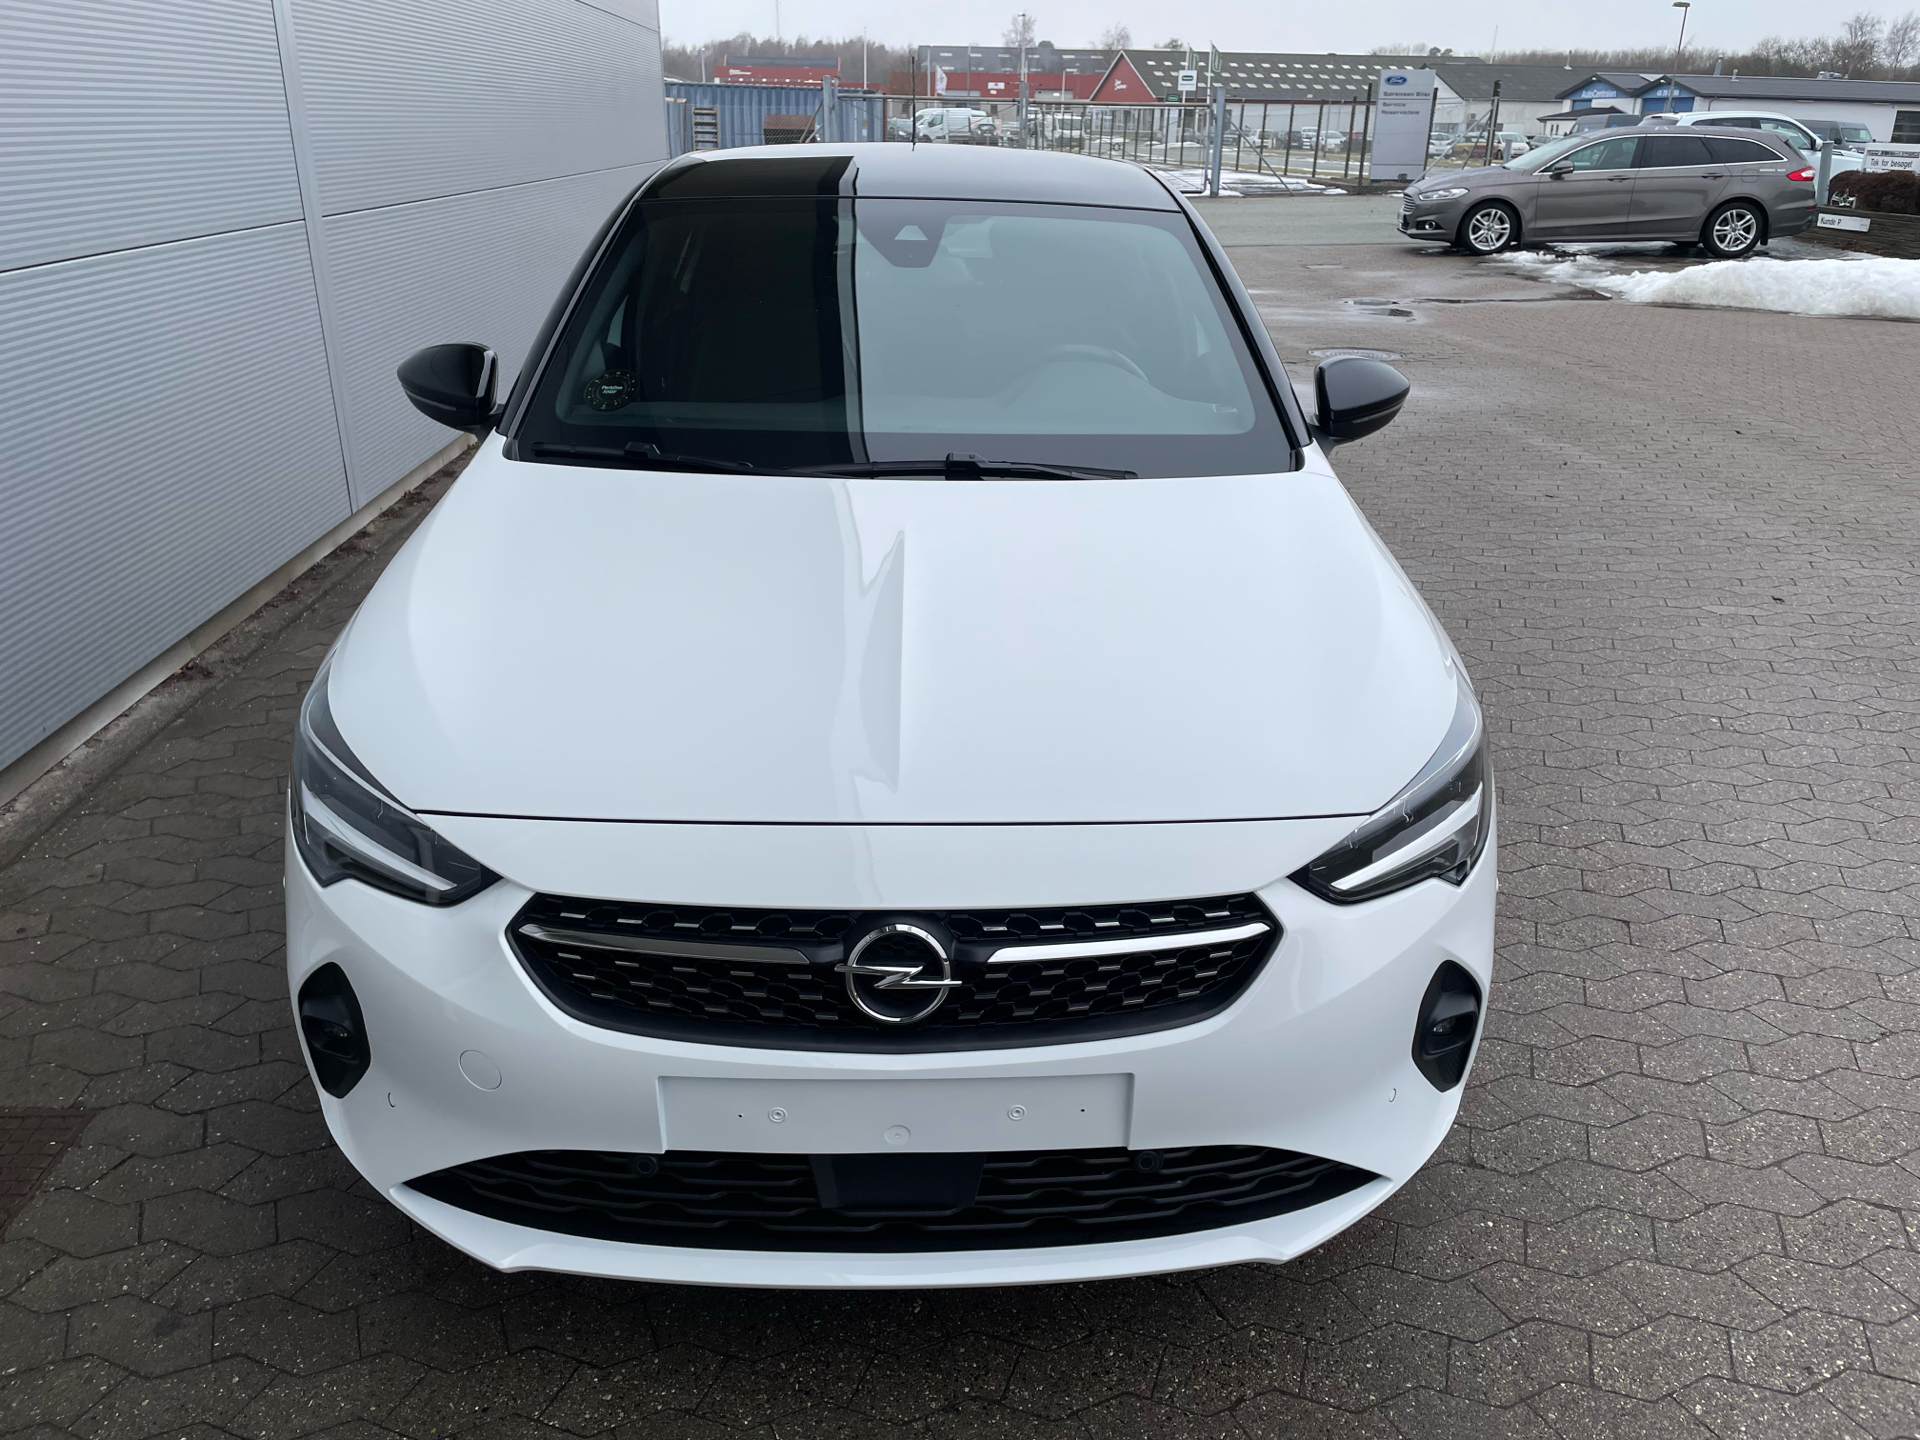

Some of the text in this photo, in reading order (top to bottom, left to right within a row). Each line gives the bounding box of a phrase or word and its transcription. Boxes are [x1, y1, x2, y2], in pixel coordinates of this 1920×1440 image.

[1870, 158, 1913, 169] Tak for besøget
[1820, 216, 1836, 226] Kunde
